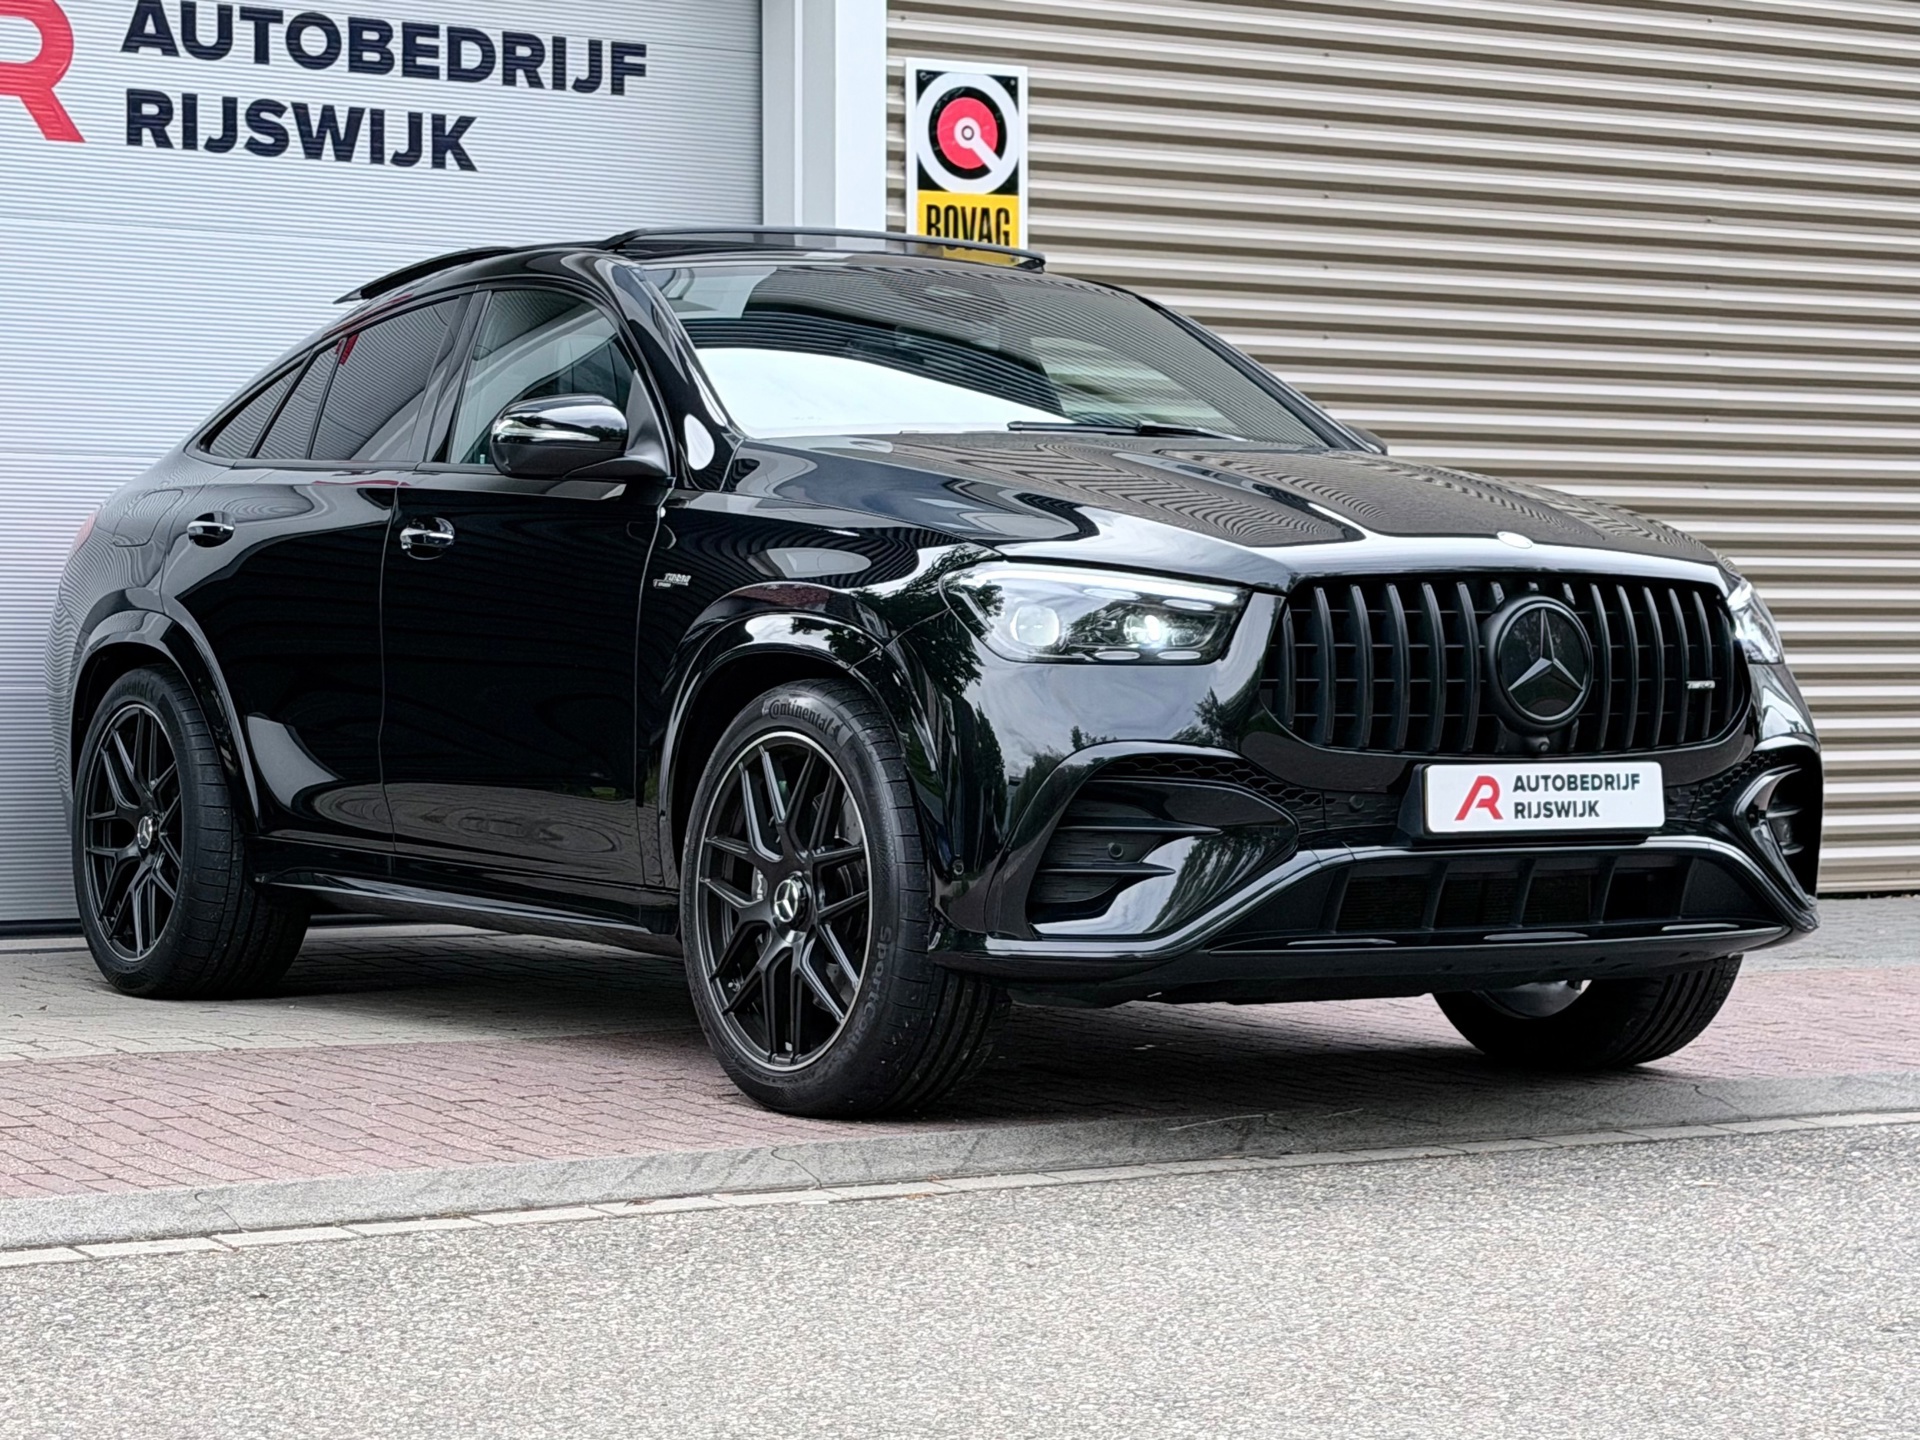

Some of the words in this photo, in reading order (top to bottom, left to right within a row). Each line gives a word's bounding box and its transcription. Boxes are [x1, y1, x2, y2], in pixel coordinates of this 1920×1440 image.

[120, 0, 647, 96] AUTOBEDRIJF
[126, 88, 478, 172] RIJSWIJK
[926, 204, 1011, 249] BOVAG
[769, 699, 836, 736] Continental
[1512, 773, 1641, 793] AUTOBEDRIJF
[1514, 800, 1600, 819] RIJSWIJK
